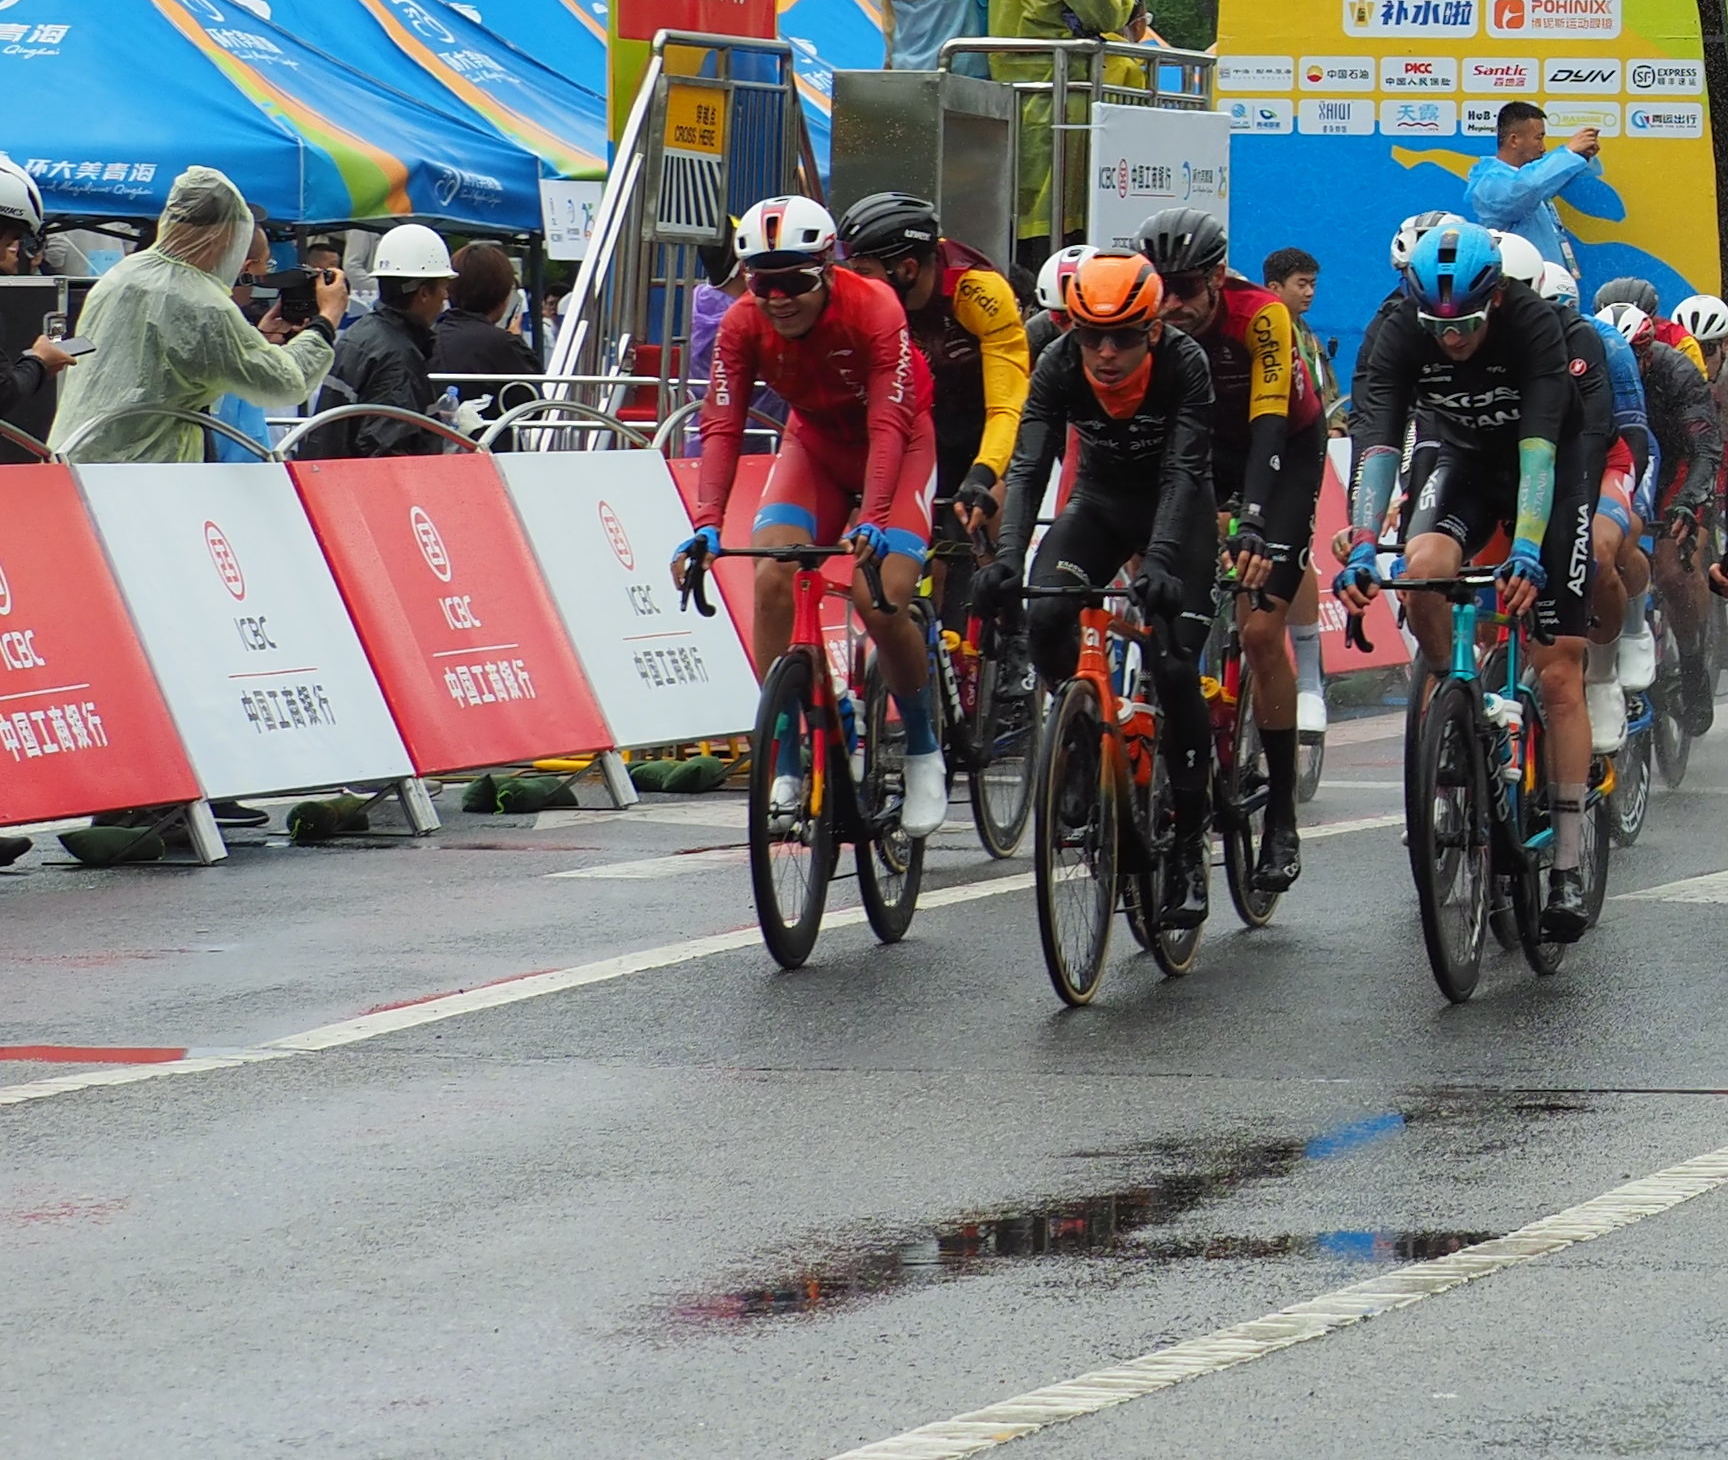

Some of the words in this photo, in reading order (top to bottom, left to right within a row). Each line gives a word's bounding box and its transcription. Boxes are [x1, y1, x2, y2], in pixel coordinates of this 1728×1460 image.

[1380, 0, 1473, 26] 补水啦
[1327, 70, 1369, 79] 中国石油
[1385, 78, 1451, 87] 中国人民保险
[1405, 63, 1432, 74] PICC
[1473, 65, 1528, 76] Santic
[1549, 70, 1617, 83] DYN
[1636, 72, 1650, 83] SF
[1658, 68, 1697, 77] EXPRESS
[675, 125, 697, 144] CROSS
[700, 128, 715, 147] HERE
[24, 158, 158, 183] 环大美青海
[959, 278, 1000, 317] Cofidis
[1252, 315, 1282, 384] Cofidis
[1567, 503, 1589, 597] ASTANA
[438, 594, 482, 631] ICBC
[625, 584, 662, 617] ICBC
[233, 615, 278, 652] ICBC
[632, 645, 711, 691] 中国工商银行
[442, 657, 537, 711] 中国工商银行
[239, 682, 337, 736] 中国工商银行
[0, 701, 110, 762] 中国工商银行
